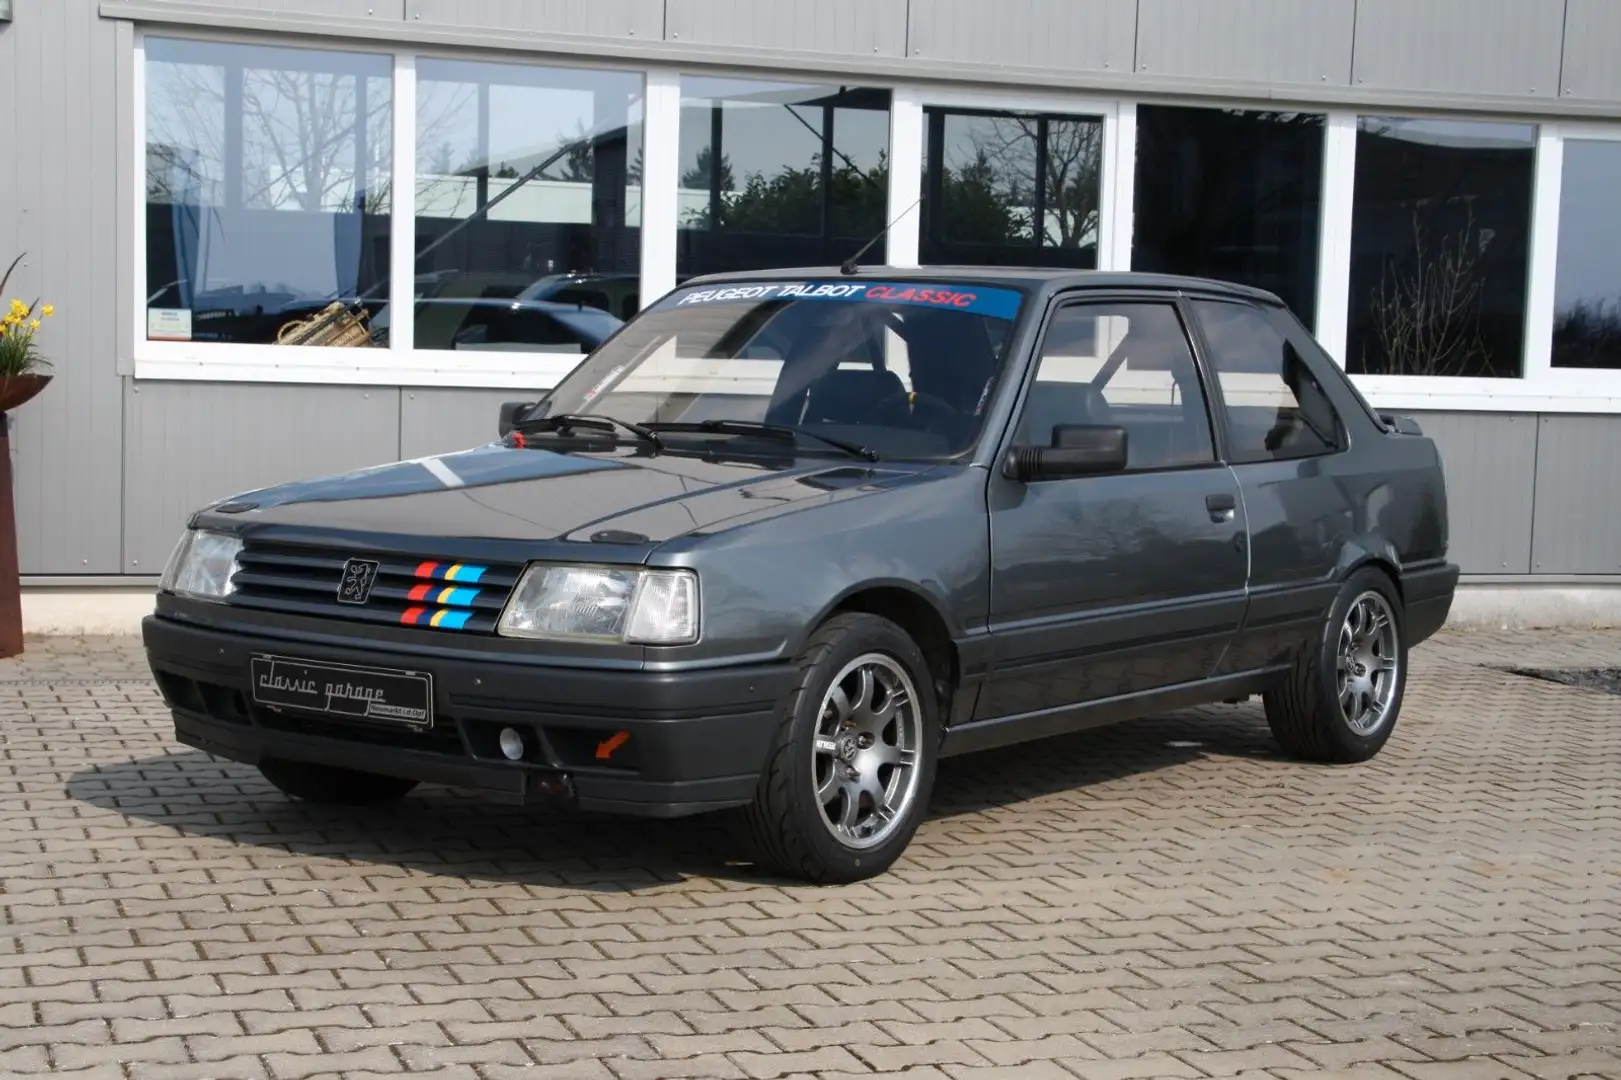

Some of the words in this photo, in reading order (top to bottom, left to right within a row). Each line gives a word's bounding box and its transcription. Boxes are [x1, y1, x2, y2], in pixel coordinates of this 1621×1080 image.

[677, 286, 778, 306] PEUGEOT
[777, 285, 867, 298] TALBOT
[865, 286, 976, 307] CLASSIC
[260, 661, 318, 694] classic
[323, 682, 386, 716] garage
